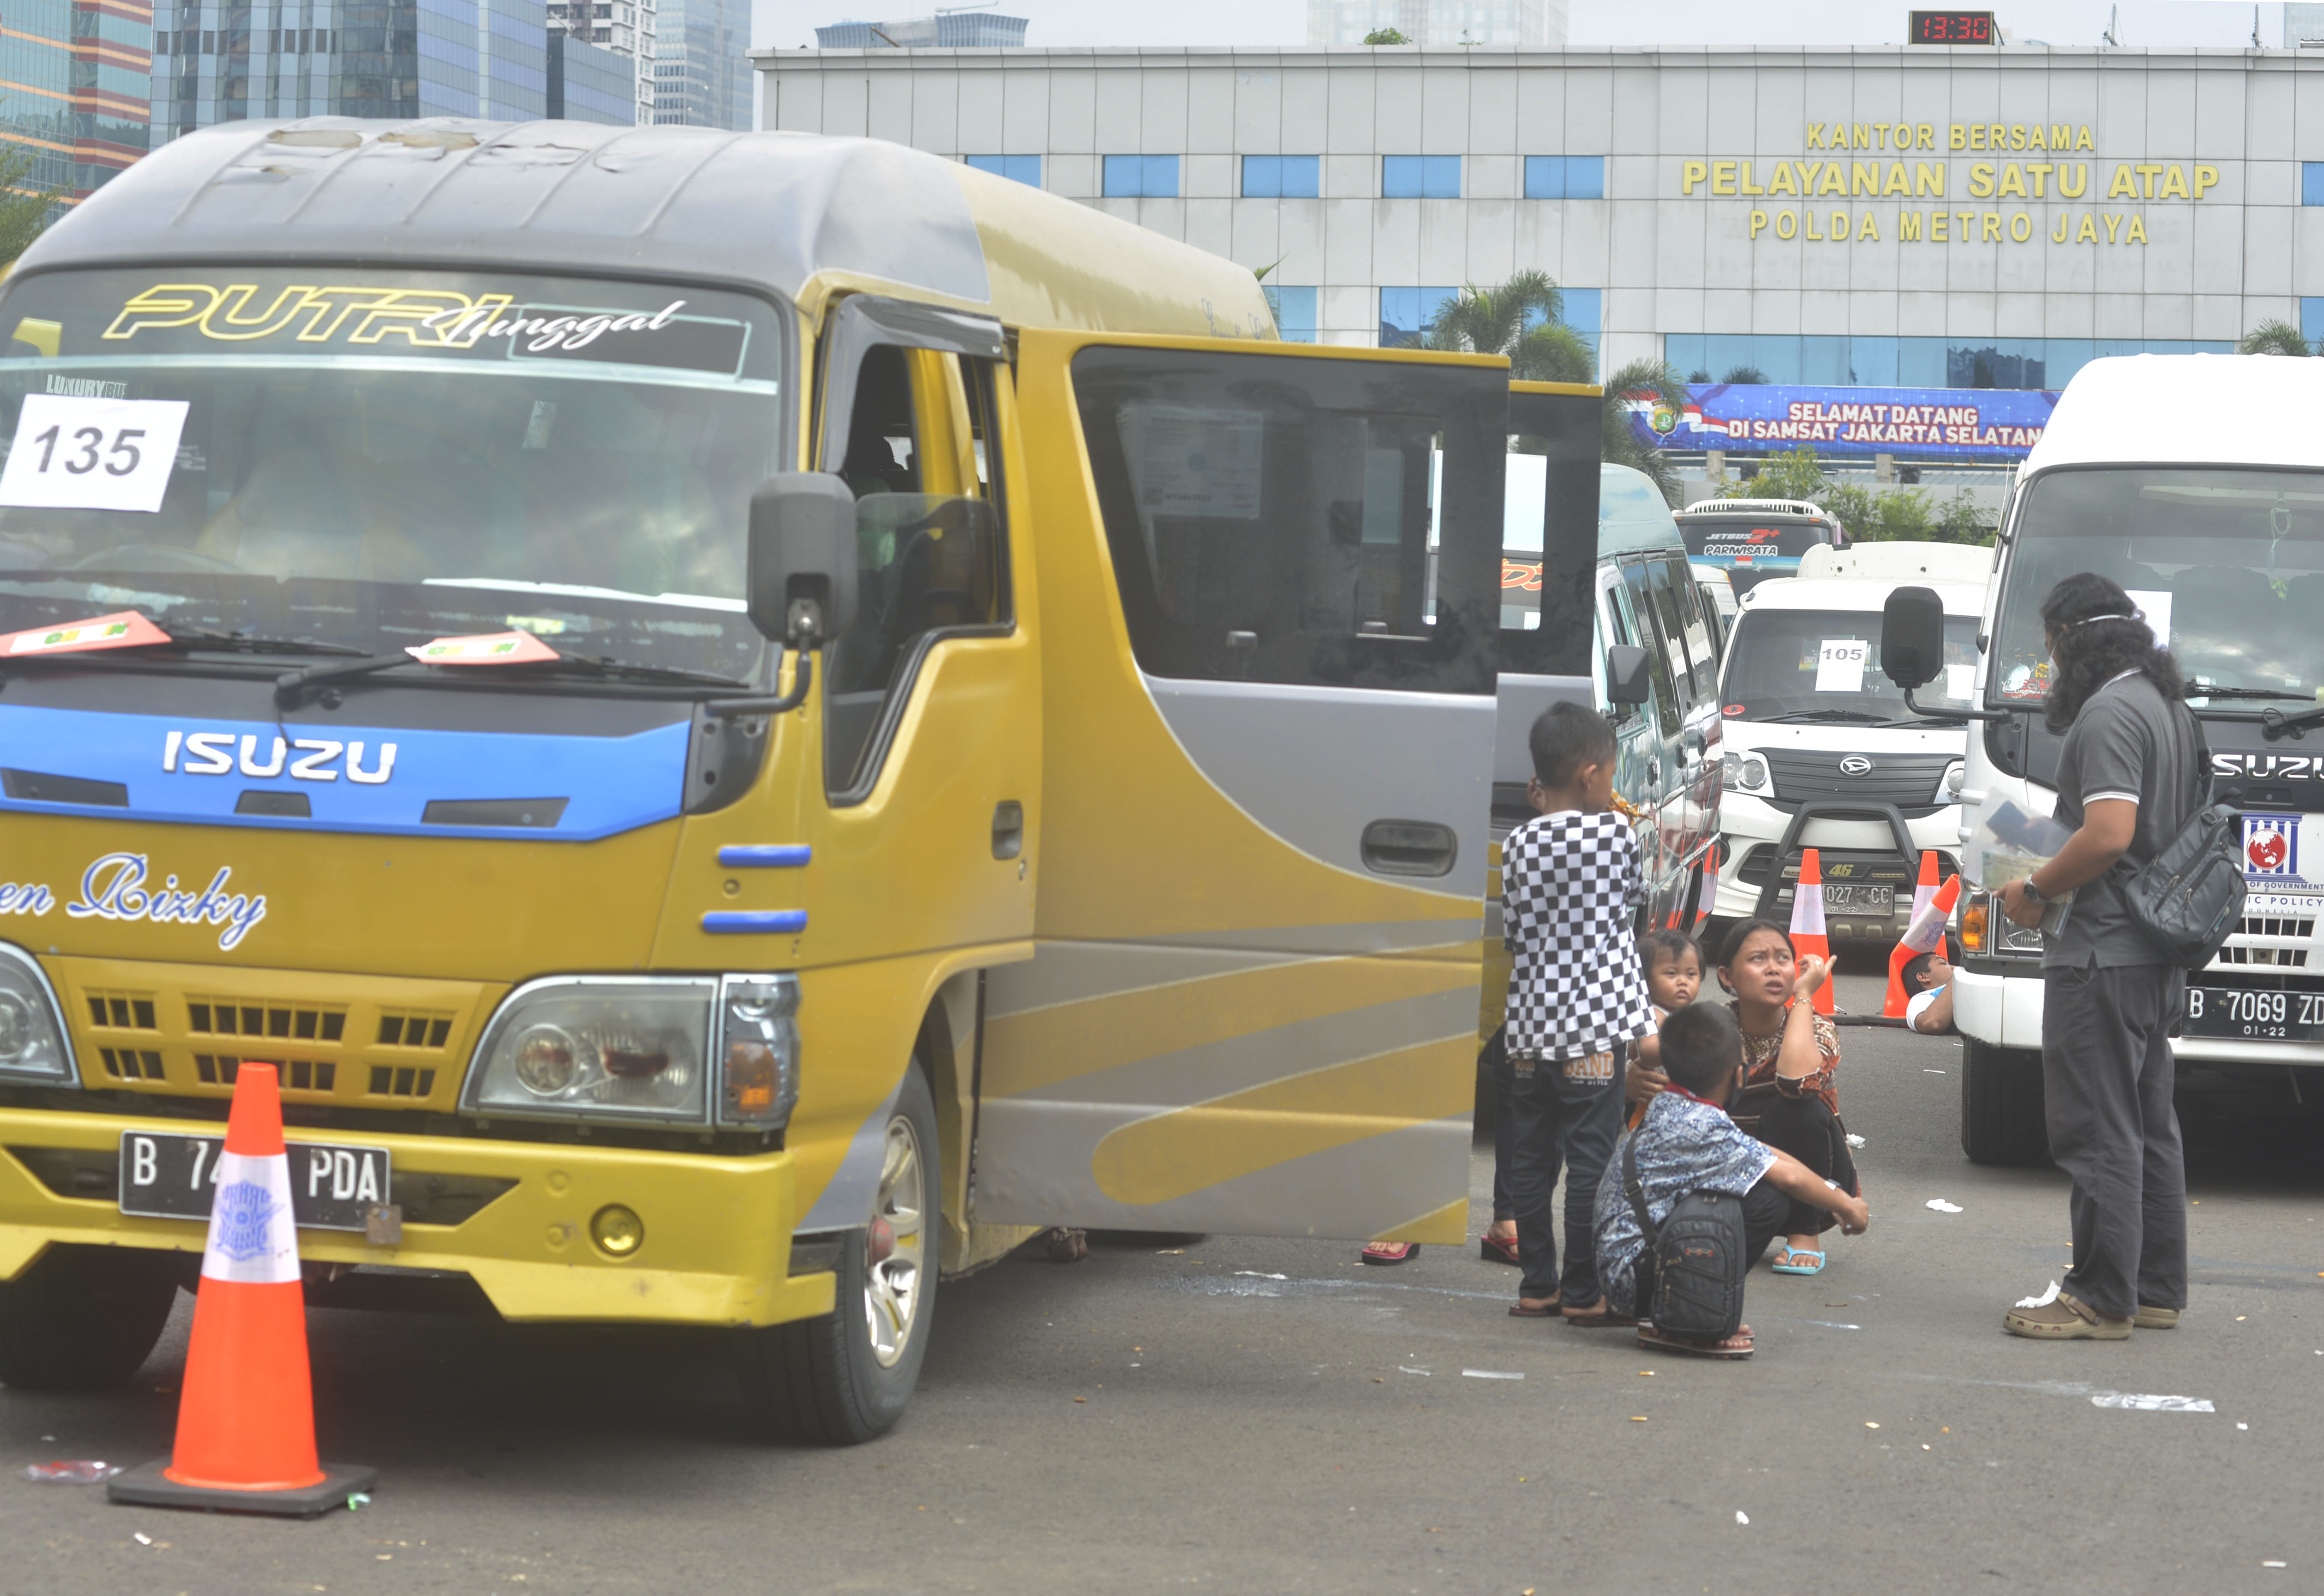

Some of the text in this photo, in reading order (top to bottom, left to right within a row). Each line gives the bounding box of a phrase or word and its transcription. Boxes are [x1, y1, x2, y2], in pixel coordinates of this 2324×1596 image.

[1924, 16, 1988, 39] 13:30
[1807, 123, 2095, 151] KANTOR BERSAMA
[1682, 161, 2220, 199] PELAYANAN SATU ATAP
[1750, 209, 2148, 244] POLDA METRO JAYA
[101, 284, 687, 352] PUTRI Tunggal
[1788, 402, 1979, 426] SELAMAT DATANG
[1728, 419, 2043, 446] DI SAMSAT JAKARTA SELATAN
[34, 425, 146, 476] 135
[1704, 545, 1778, 556] PARIWISATA
[1822, 648, 1862, 660] 105
[163, 731, 397, 784] ISUZU
[2212, 754, 2324, 782] SUZ
[1829, 864, 1854, 877] 46
[1871, 887, 1889, 904] CC
[2264, 882, 2324, 890] GOVERNMENT
[0, 851, 267, 952] en Rizky
[2271, 896, 2323, 907] POLICY
[2189, 989, 2204, 1019] B
[2227, 991, 2286, 1023] 7069
[133, 1137, 158, 1186] B
[309, 1147, 380, 1202] PDA
